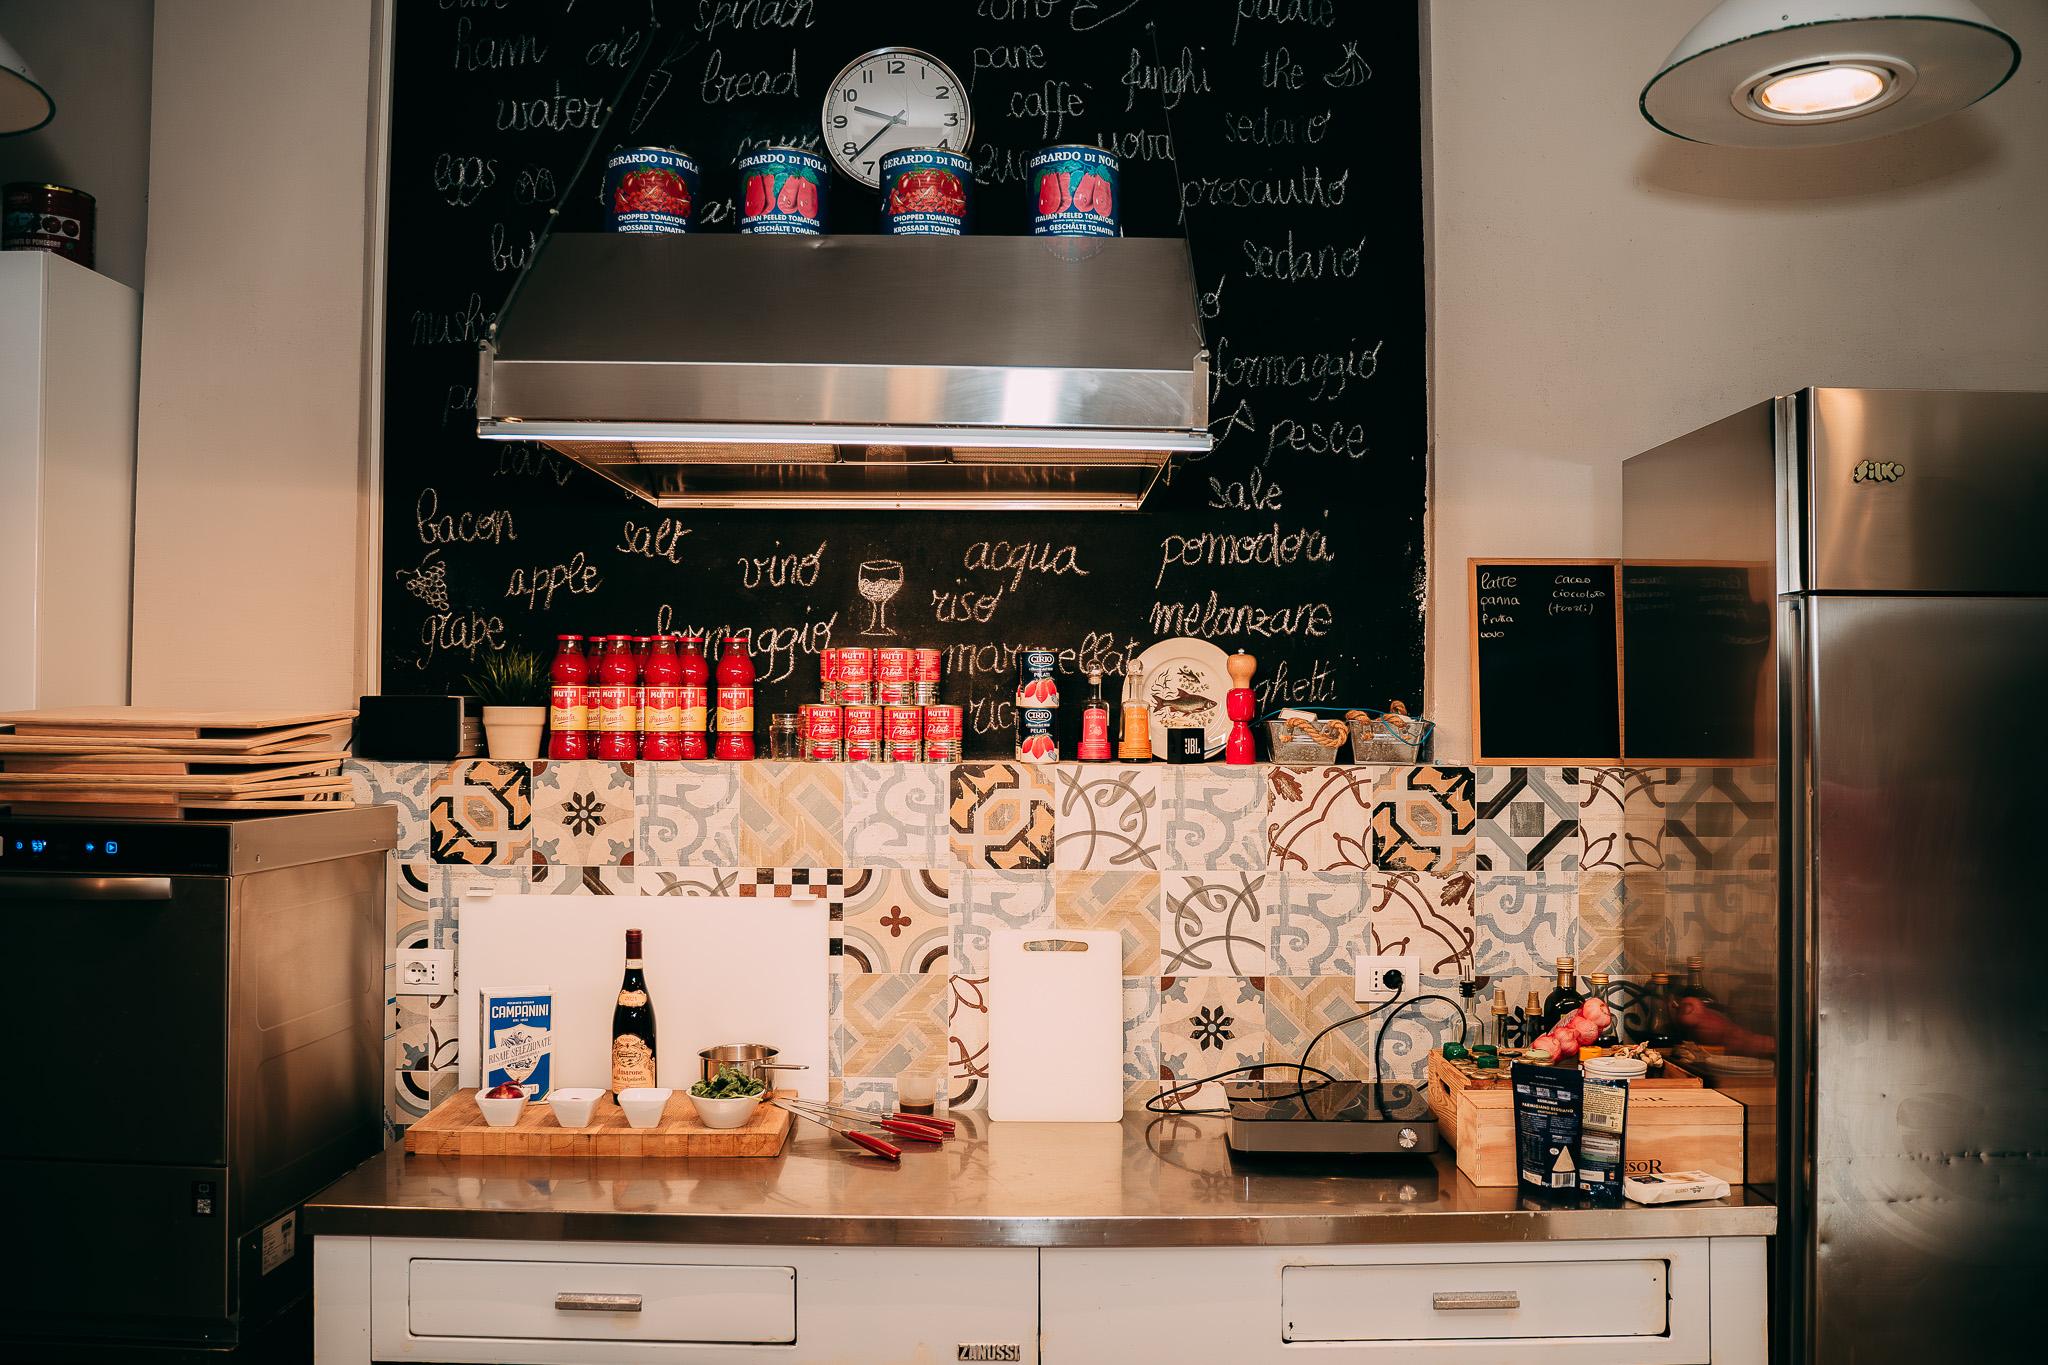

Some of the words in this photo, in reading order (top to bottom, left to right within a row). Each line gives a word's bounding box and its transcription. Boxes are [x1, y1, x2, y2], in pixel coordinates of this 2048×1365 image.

[887, 60, 905, 74] 12
[970, 44, 1047, 93] pane
[700, 48, 800, 104] bread
[862, 70, 873, 84] 11
[1121, 46, 1211, 112] funghi
[843, 88, 858, 103] 10
[935, 86, 950, 100] 2
[496, 79, 603, 131] water
[833, 115, 848, 129] 9
[943, 112, 959, 127] 3
[842, 141, 857, 155] 8
[936, 138, 949, 150] 4
[608, 154, 658, 168] GERARDO
[661, 155, 673, 166] DI
[675, 158, 699, 174] NOLA
[739, 154, 785, 170] GERARDO
[789, 155, 800, 165] DI
[803, 157, 827, 174] NOLA
[862, 161, 876, 175] 7
[883, 155, 933, 171] GERARDO
[936, 156, 948, 166] DI
[950, 158, 973, 174] NOLA
[1030, 152, 1081, 168] GERARDO
[1084, 153, 1096, 163] DI
[1098, 155, 1119, 171] NOLA
[618, 213, 649, 223] CHOPPED
[651, 213, 687, 225] TOMATOES
[742, 214, 763, 223] ITALIAN
[763, 214, 788, 222] PEELED
[788, 214, 820, 227] TOMATOES
[893, 214, 924, 223] CHOPPED
[926, 214, 961, 225] TOMATOES
[1035, 213, 1058, 223] ITALIAN
[1058, 212, 1083, 220] PEELED
[1084, 213, 1115, 225] TOMATOES
[618, 224, 653, 233] KROSSADE
[893, 225, 928, 233] KROSSADE
[929, 226, 961, 235] TOMATER
[1243, 230, 1366, 283] sedano
[1209, 336, 1383, 404] formaggio
[1263, 419, 1369, 467] pesce
[1208, 466, 1282, 511] sale
[416, 487, 518, 545] bacon
[616, 517, 693, 564] salt
[1155, 509, 1335, 589] pomodori
[737, 538, 827, 588] vino
[963, 541, 1090, 592] acqua
[504, 552, 603, 610] apple
[1481, 572, 1517, 590] latte
[931, 578, 1004, 622] riso
[1480, 596, 1520, 612] panna
[1149, 590, 1332, 638] melanzane
[416, 612, 506, 670] grape
[1030, 655, 1052, 663] CIRIO
[553, 690, 577, 698] MUTTI
[1027, 711, 1050, 719] CIRIO
[1185, 738, 1201, 754] JBL
[492, 1004, 549, 1018] CAMPANINI
[959, 1344, 1020, 1361] ZANUSSI
